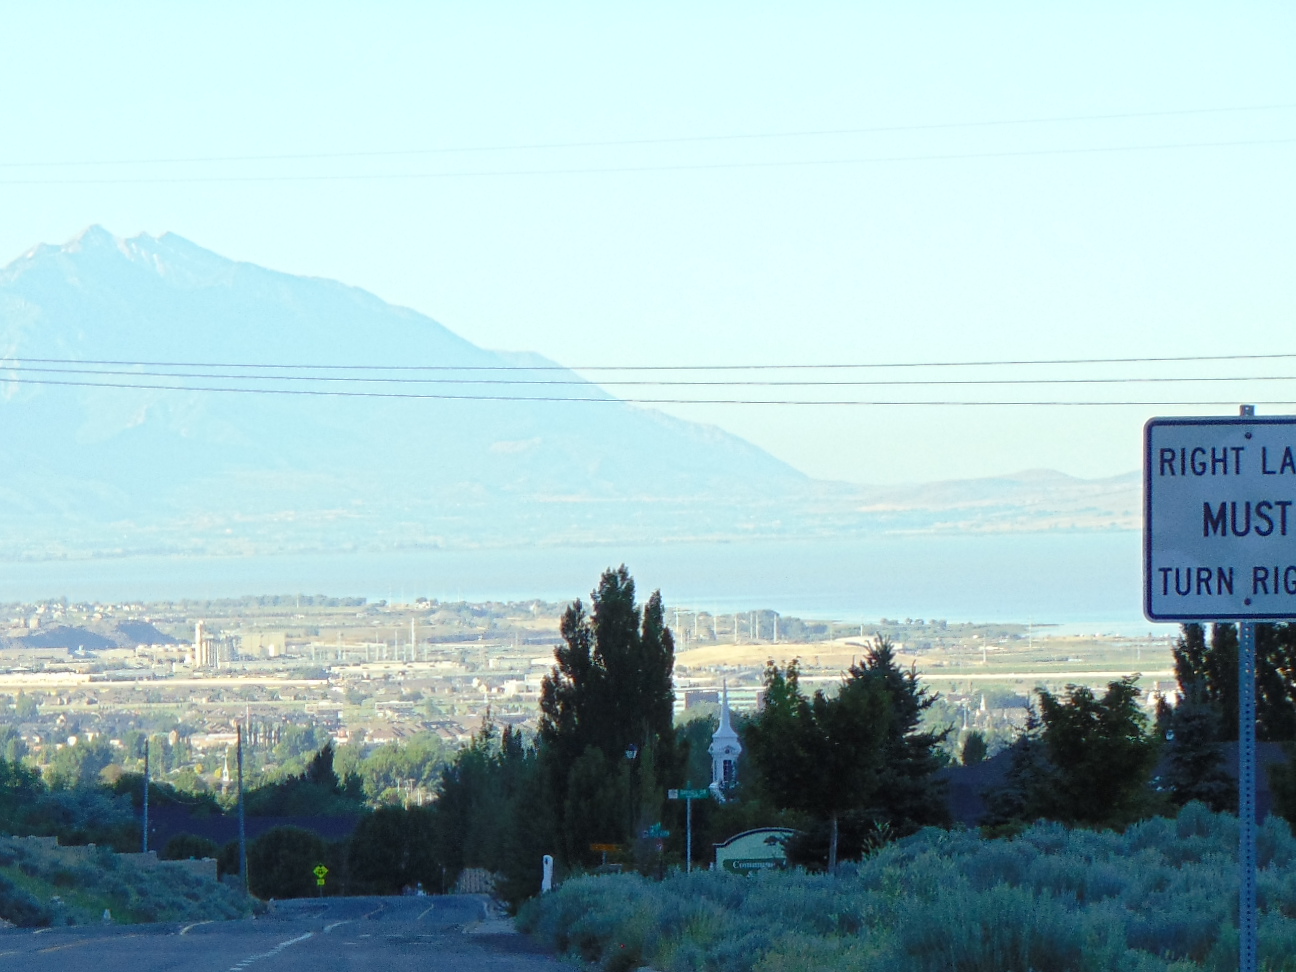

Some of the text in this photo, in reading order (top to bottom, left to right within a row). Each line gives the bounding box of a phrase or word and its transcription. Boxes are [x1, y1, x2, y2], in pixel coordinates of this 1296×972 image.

[1159, 446, 1245, 477] RIGHT
[1203, 501, 1293, 538] MUST
[1158, 566, 1234, 596] TURN
